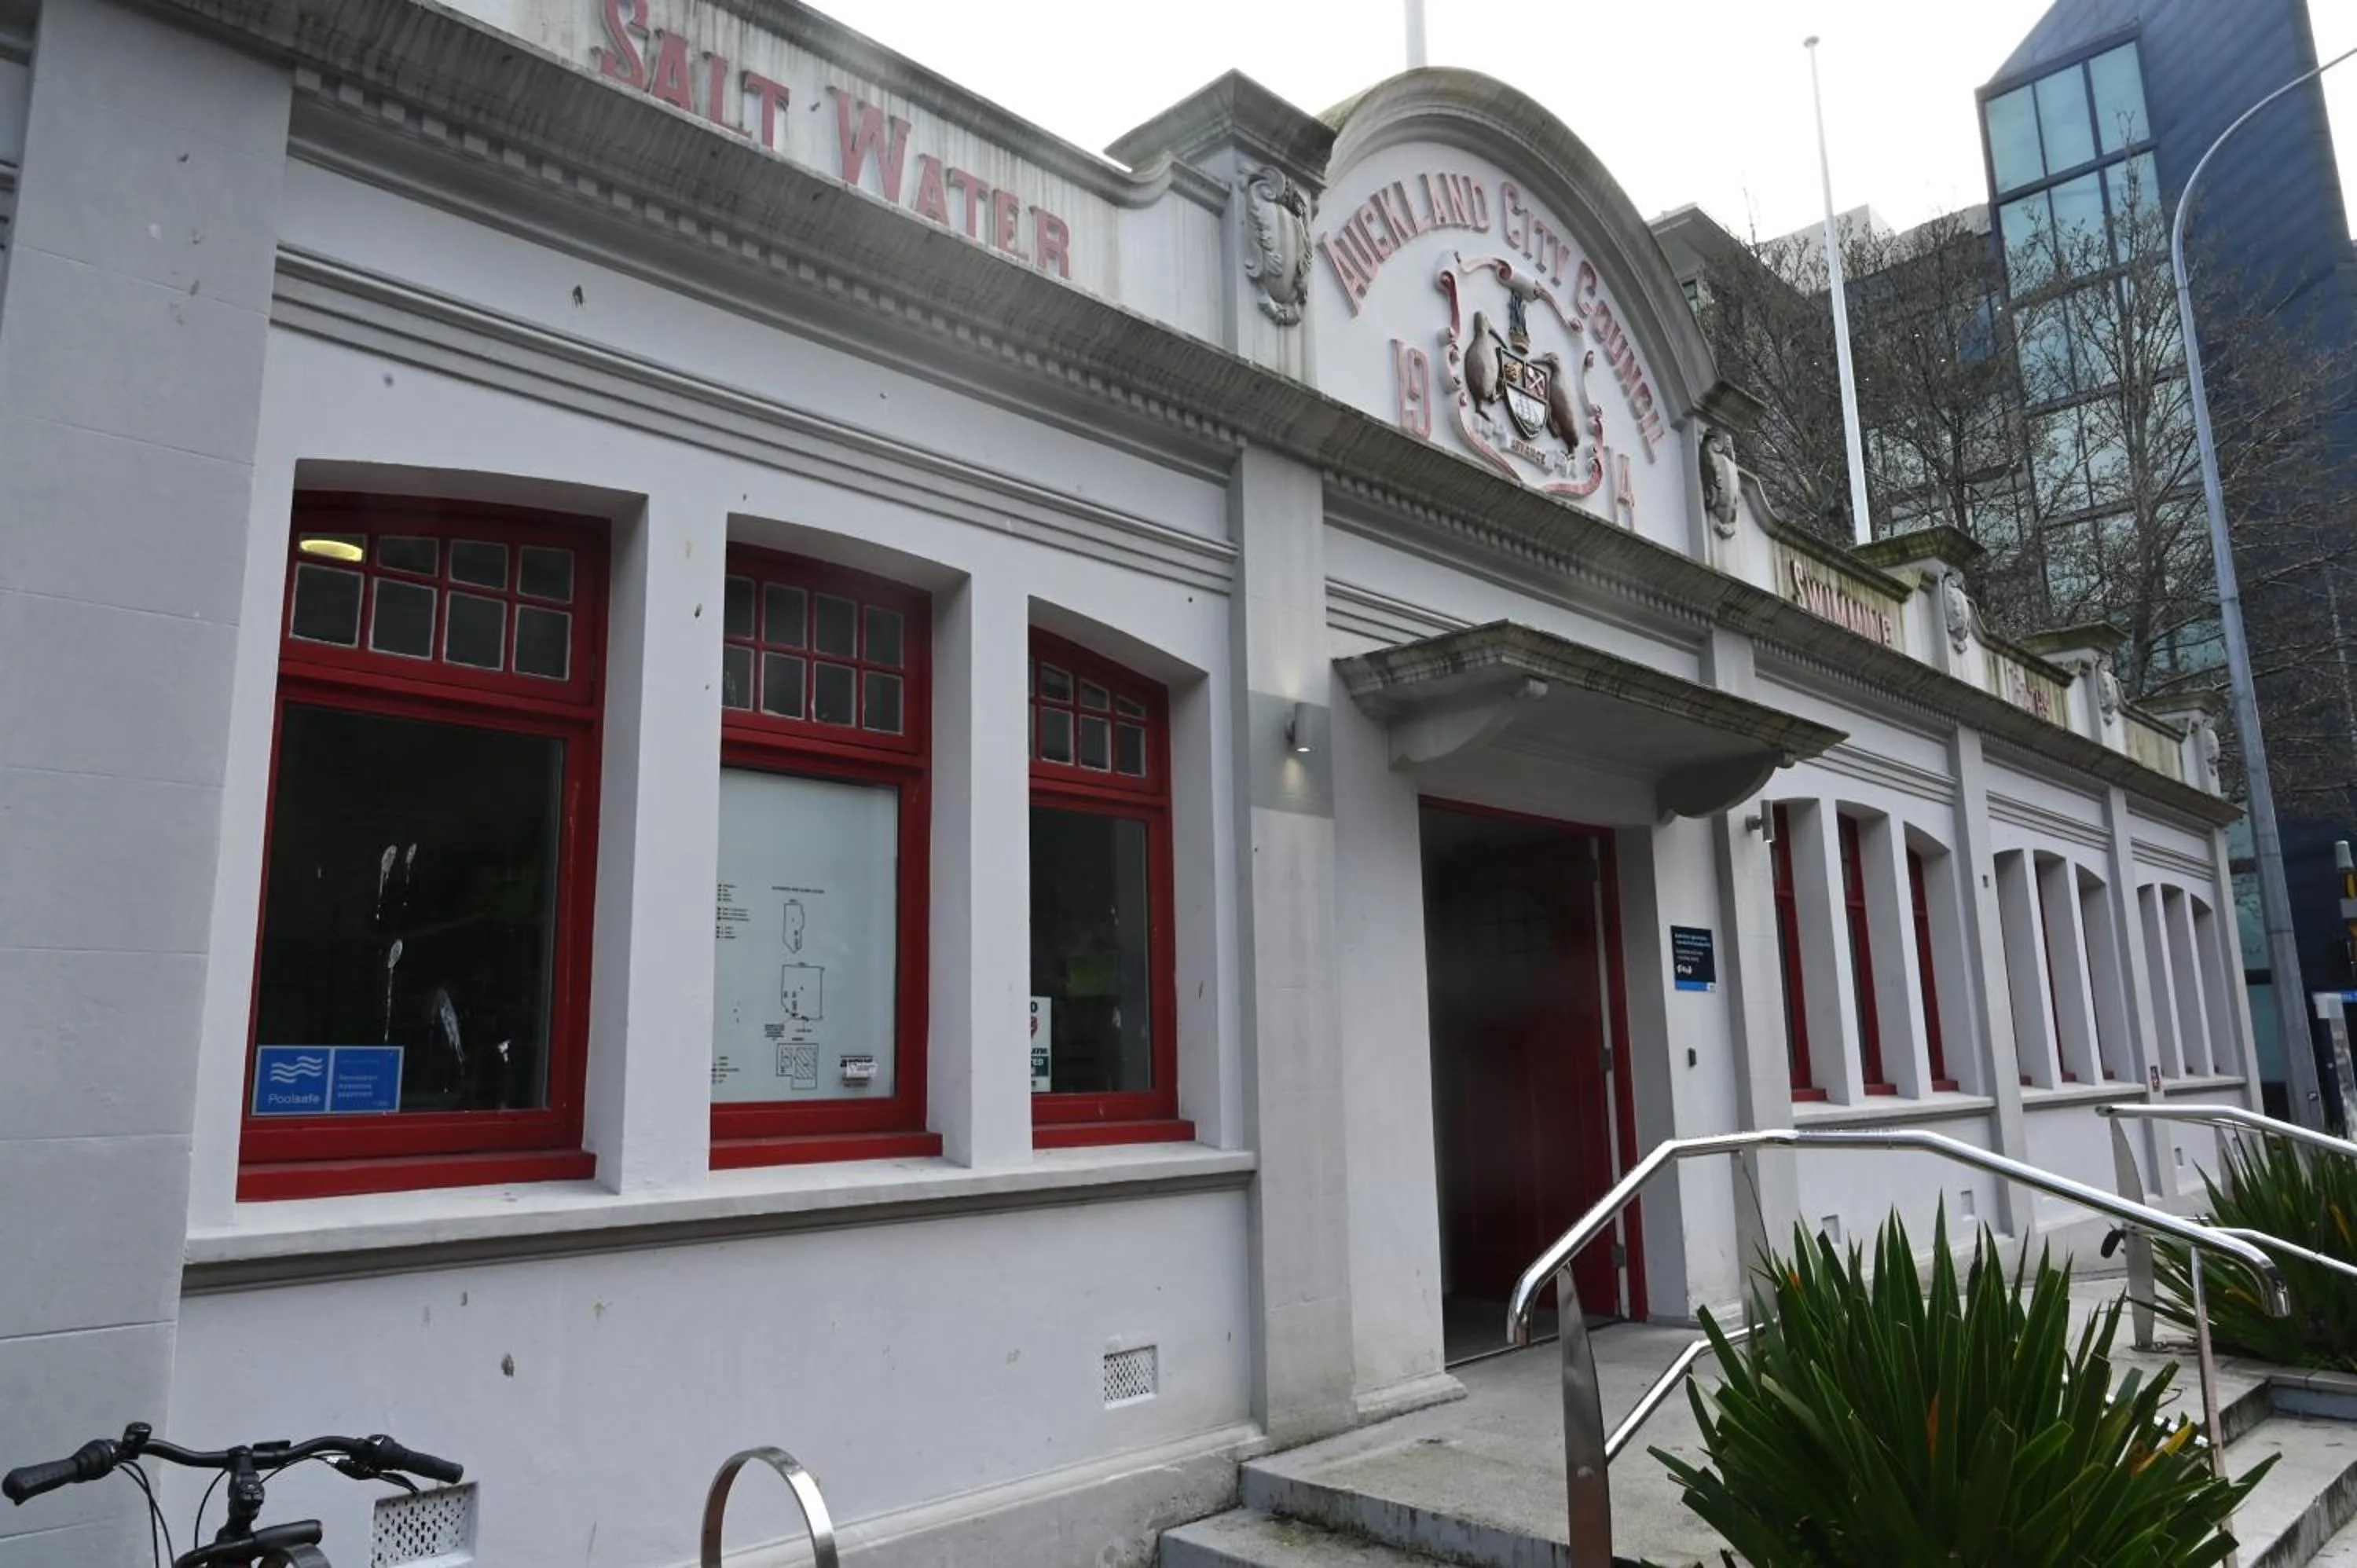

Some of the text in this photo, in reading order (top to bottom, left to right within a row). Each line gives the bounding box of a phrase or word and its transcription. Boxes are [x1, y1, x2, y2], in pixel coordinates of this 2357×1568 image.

[592, 0, 1070, 280] SALT WATER
[1320, 171, 1664, 465] AUCKLAND CITY COUNCIL
[1391, 338, 1431, 441] 19
[1791, 559, 1893, 647] SWIMMING
[269, 1093, 321, 1105] Poolsafe
